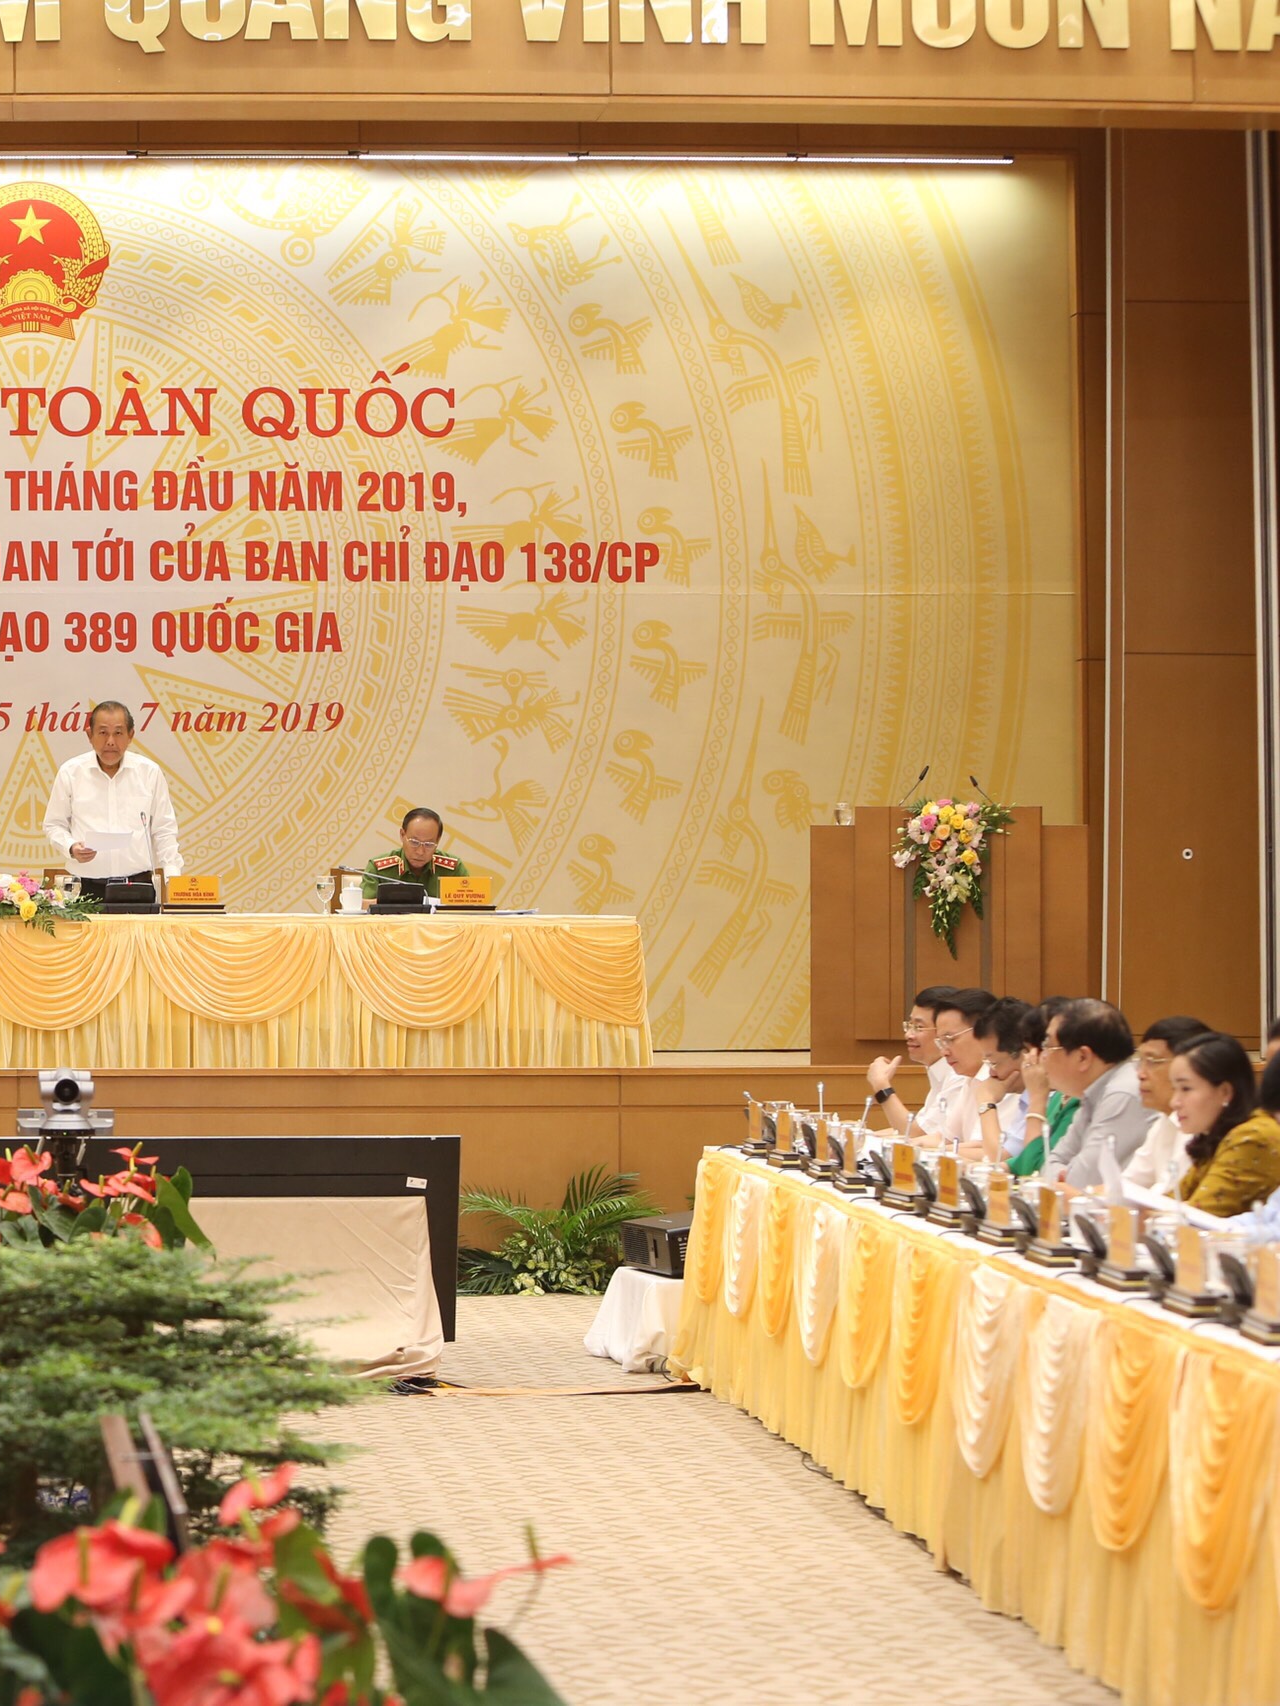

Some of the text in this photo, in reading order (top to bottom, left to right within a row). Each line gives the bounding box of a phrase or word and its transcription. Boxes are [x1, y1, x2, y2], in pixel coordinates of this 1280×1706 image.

[12, 312, 51, 321] VIỆT NAM
[0, 370, 218, 438] TOÀN
[241, 361, 455, 442] QUỐC
[4, 461, 139, 512] THÁNG
[151, 455, 234, 512] ĐẦU
[248, 462, 343, 512] NĂM
[357, 470, 468, 517] 2019,
[72, 527, 134, 582] TỚI
[149, 522, 231, 582] CỦA
[245, 540, 329, 582] BAN
[343, 525, 411, 583] CHỈ
[423, 541, 505, 592] ĐẠO
[520, 541, 660, 584] 138/CP
[64, 611, 137, 653] 389
[152, 596, 260, 658] QUỐC
[275, 611, 343, 653] GIA
[24, 701, 94, 732] thá
[139, 702, 160, 732] 7
[170, 703, 248, 733] năm
[258, 702, 345, 733] 2019
